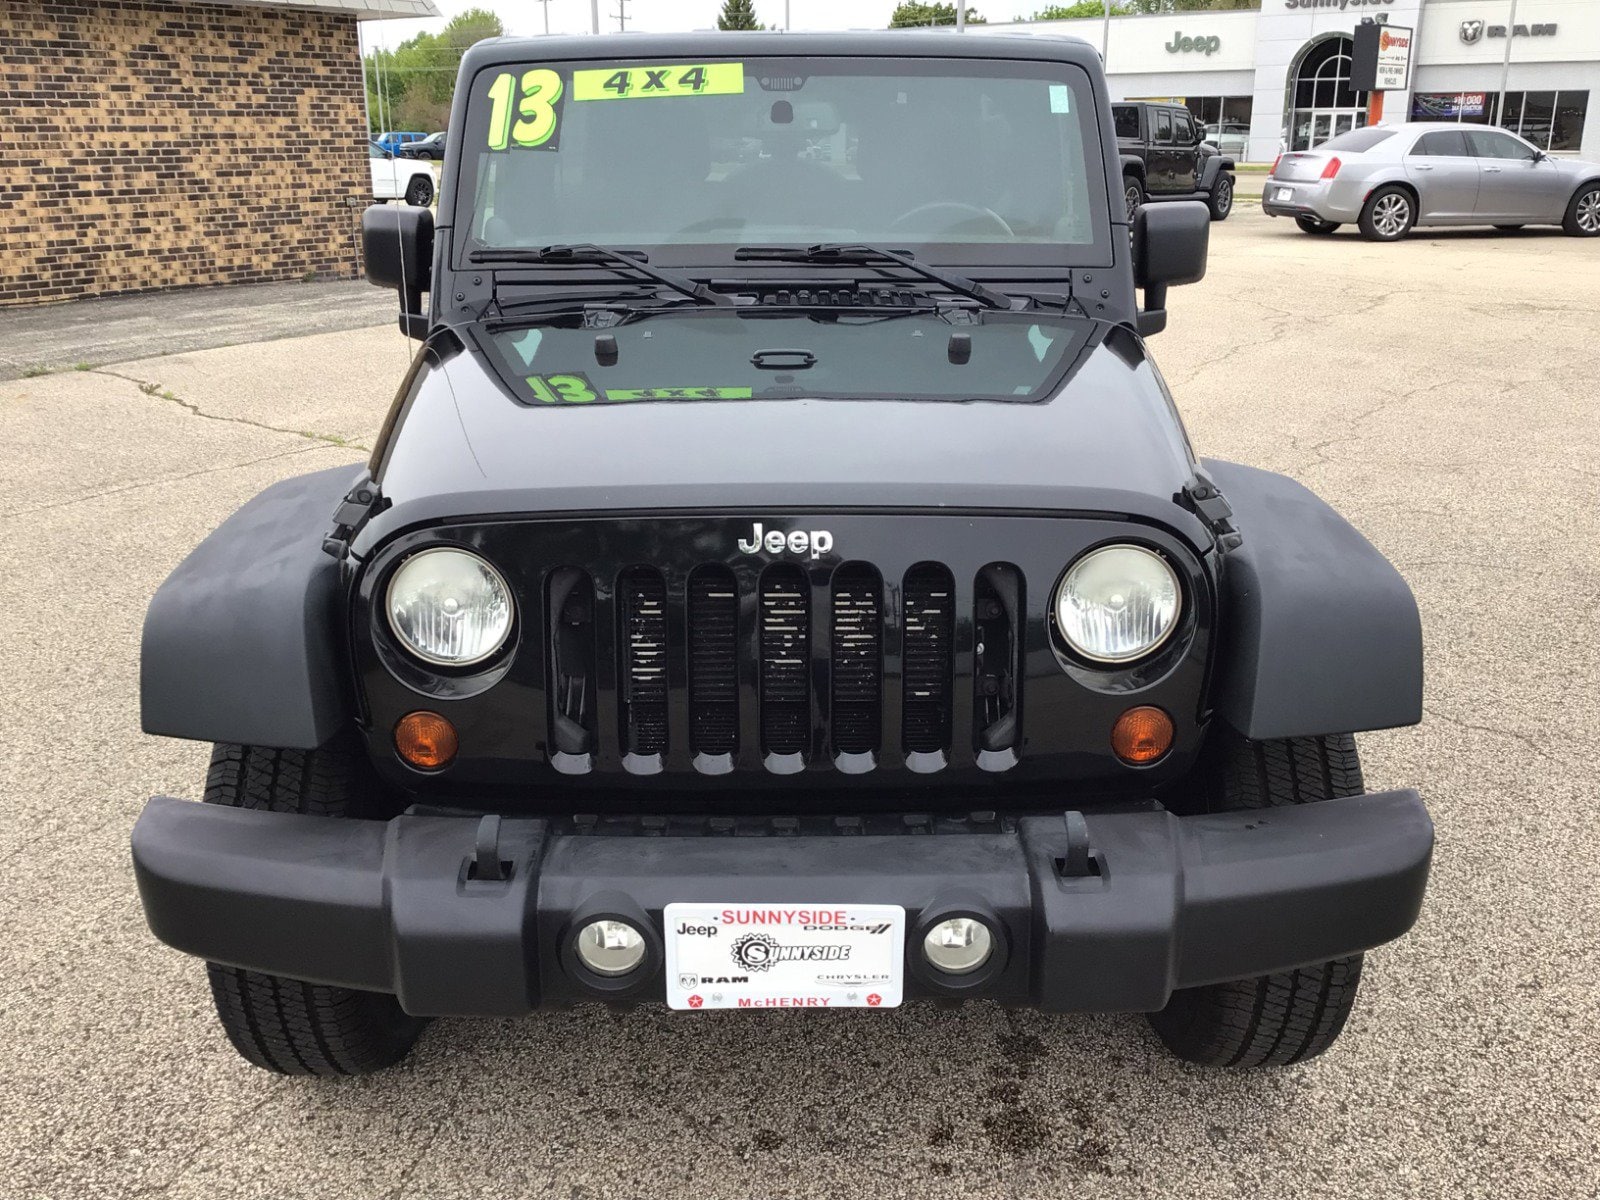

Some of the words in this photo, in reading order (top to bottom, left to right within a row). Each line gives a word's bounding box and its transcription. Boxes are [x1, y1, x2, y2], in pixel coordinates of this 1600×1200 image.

[1285, 0, 1394, 10] Sunny
[1487, 23, 1557, 37] RAM
[1165, 31, 1220, 56] Jeep
[487, 69, 563, 150] 13
[738, 523, 833, 559] Jeep
[722, 910, 847, 924] SUNNYSIDE
[677, 923, 718, 938] Jeep
[745, 945, 851, 962] SUNNYSIDE
[701, 976, 749, 984] RAM
[738, 998, 831, 1007] McHENRY
